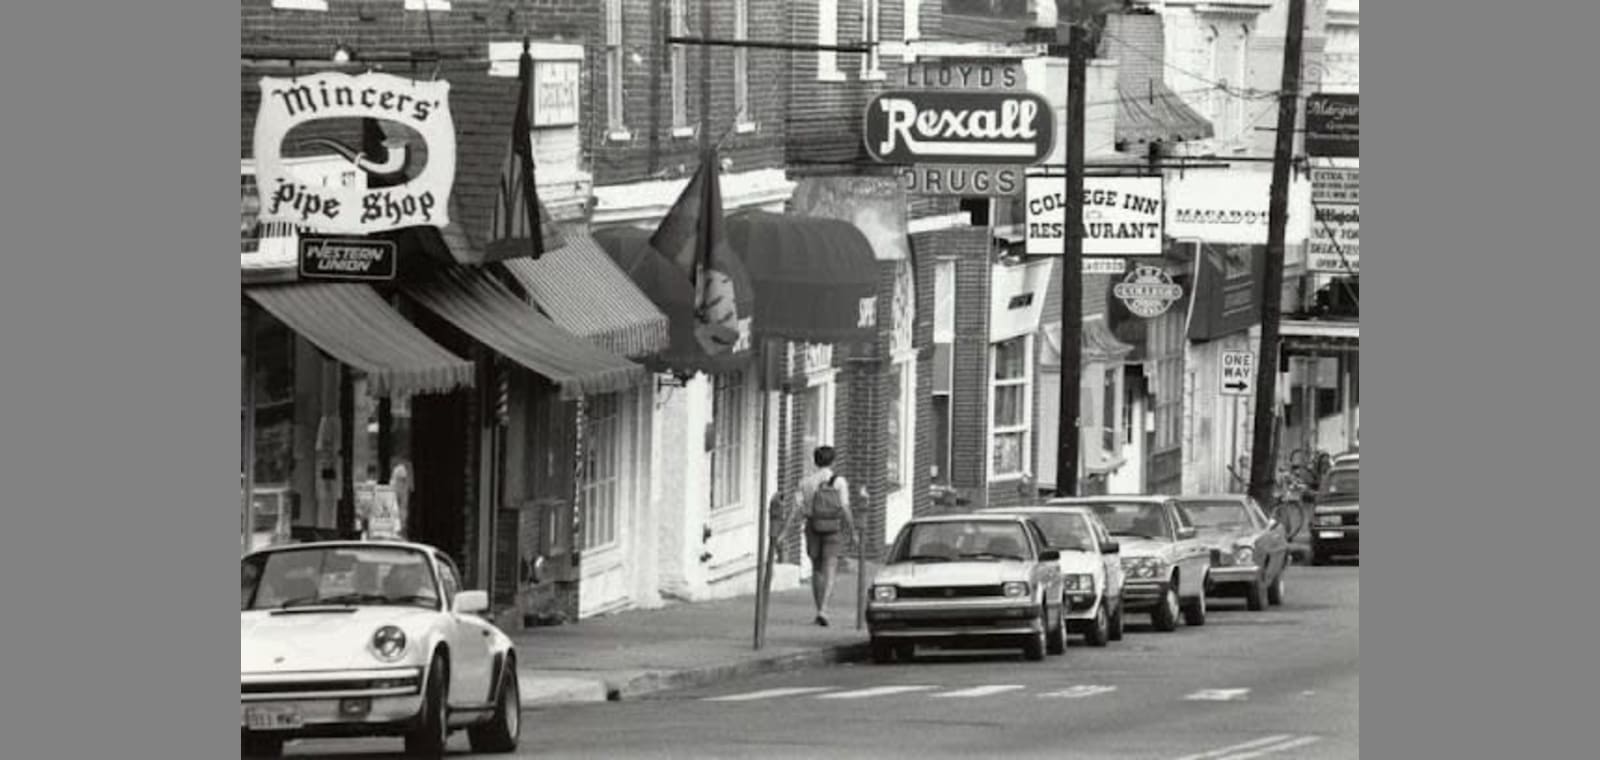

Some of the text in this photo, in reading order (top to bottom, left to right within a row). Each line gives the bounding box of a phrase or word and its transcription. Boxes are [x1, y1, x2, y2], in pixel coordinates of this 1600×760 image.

[906, 65, 1016, 87] LLOYDS
[879, 98, 1038, 156] Rexall
[269, 177, 435, 225] Pipe Shop
[1029, 190, 1159, 216] COLEGE INN
[307, 239, 384, 261] WESTERN
[317, 258, 371, 272] UNION
[1224, 354, 1250, 366] ONE
[1224, 367, 1250, 377] WAY
